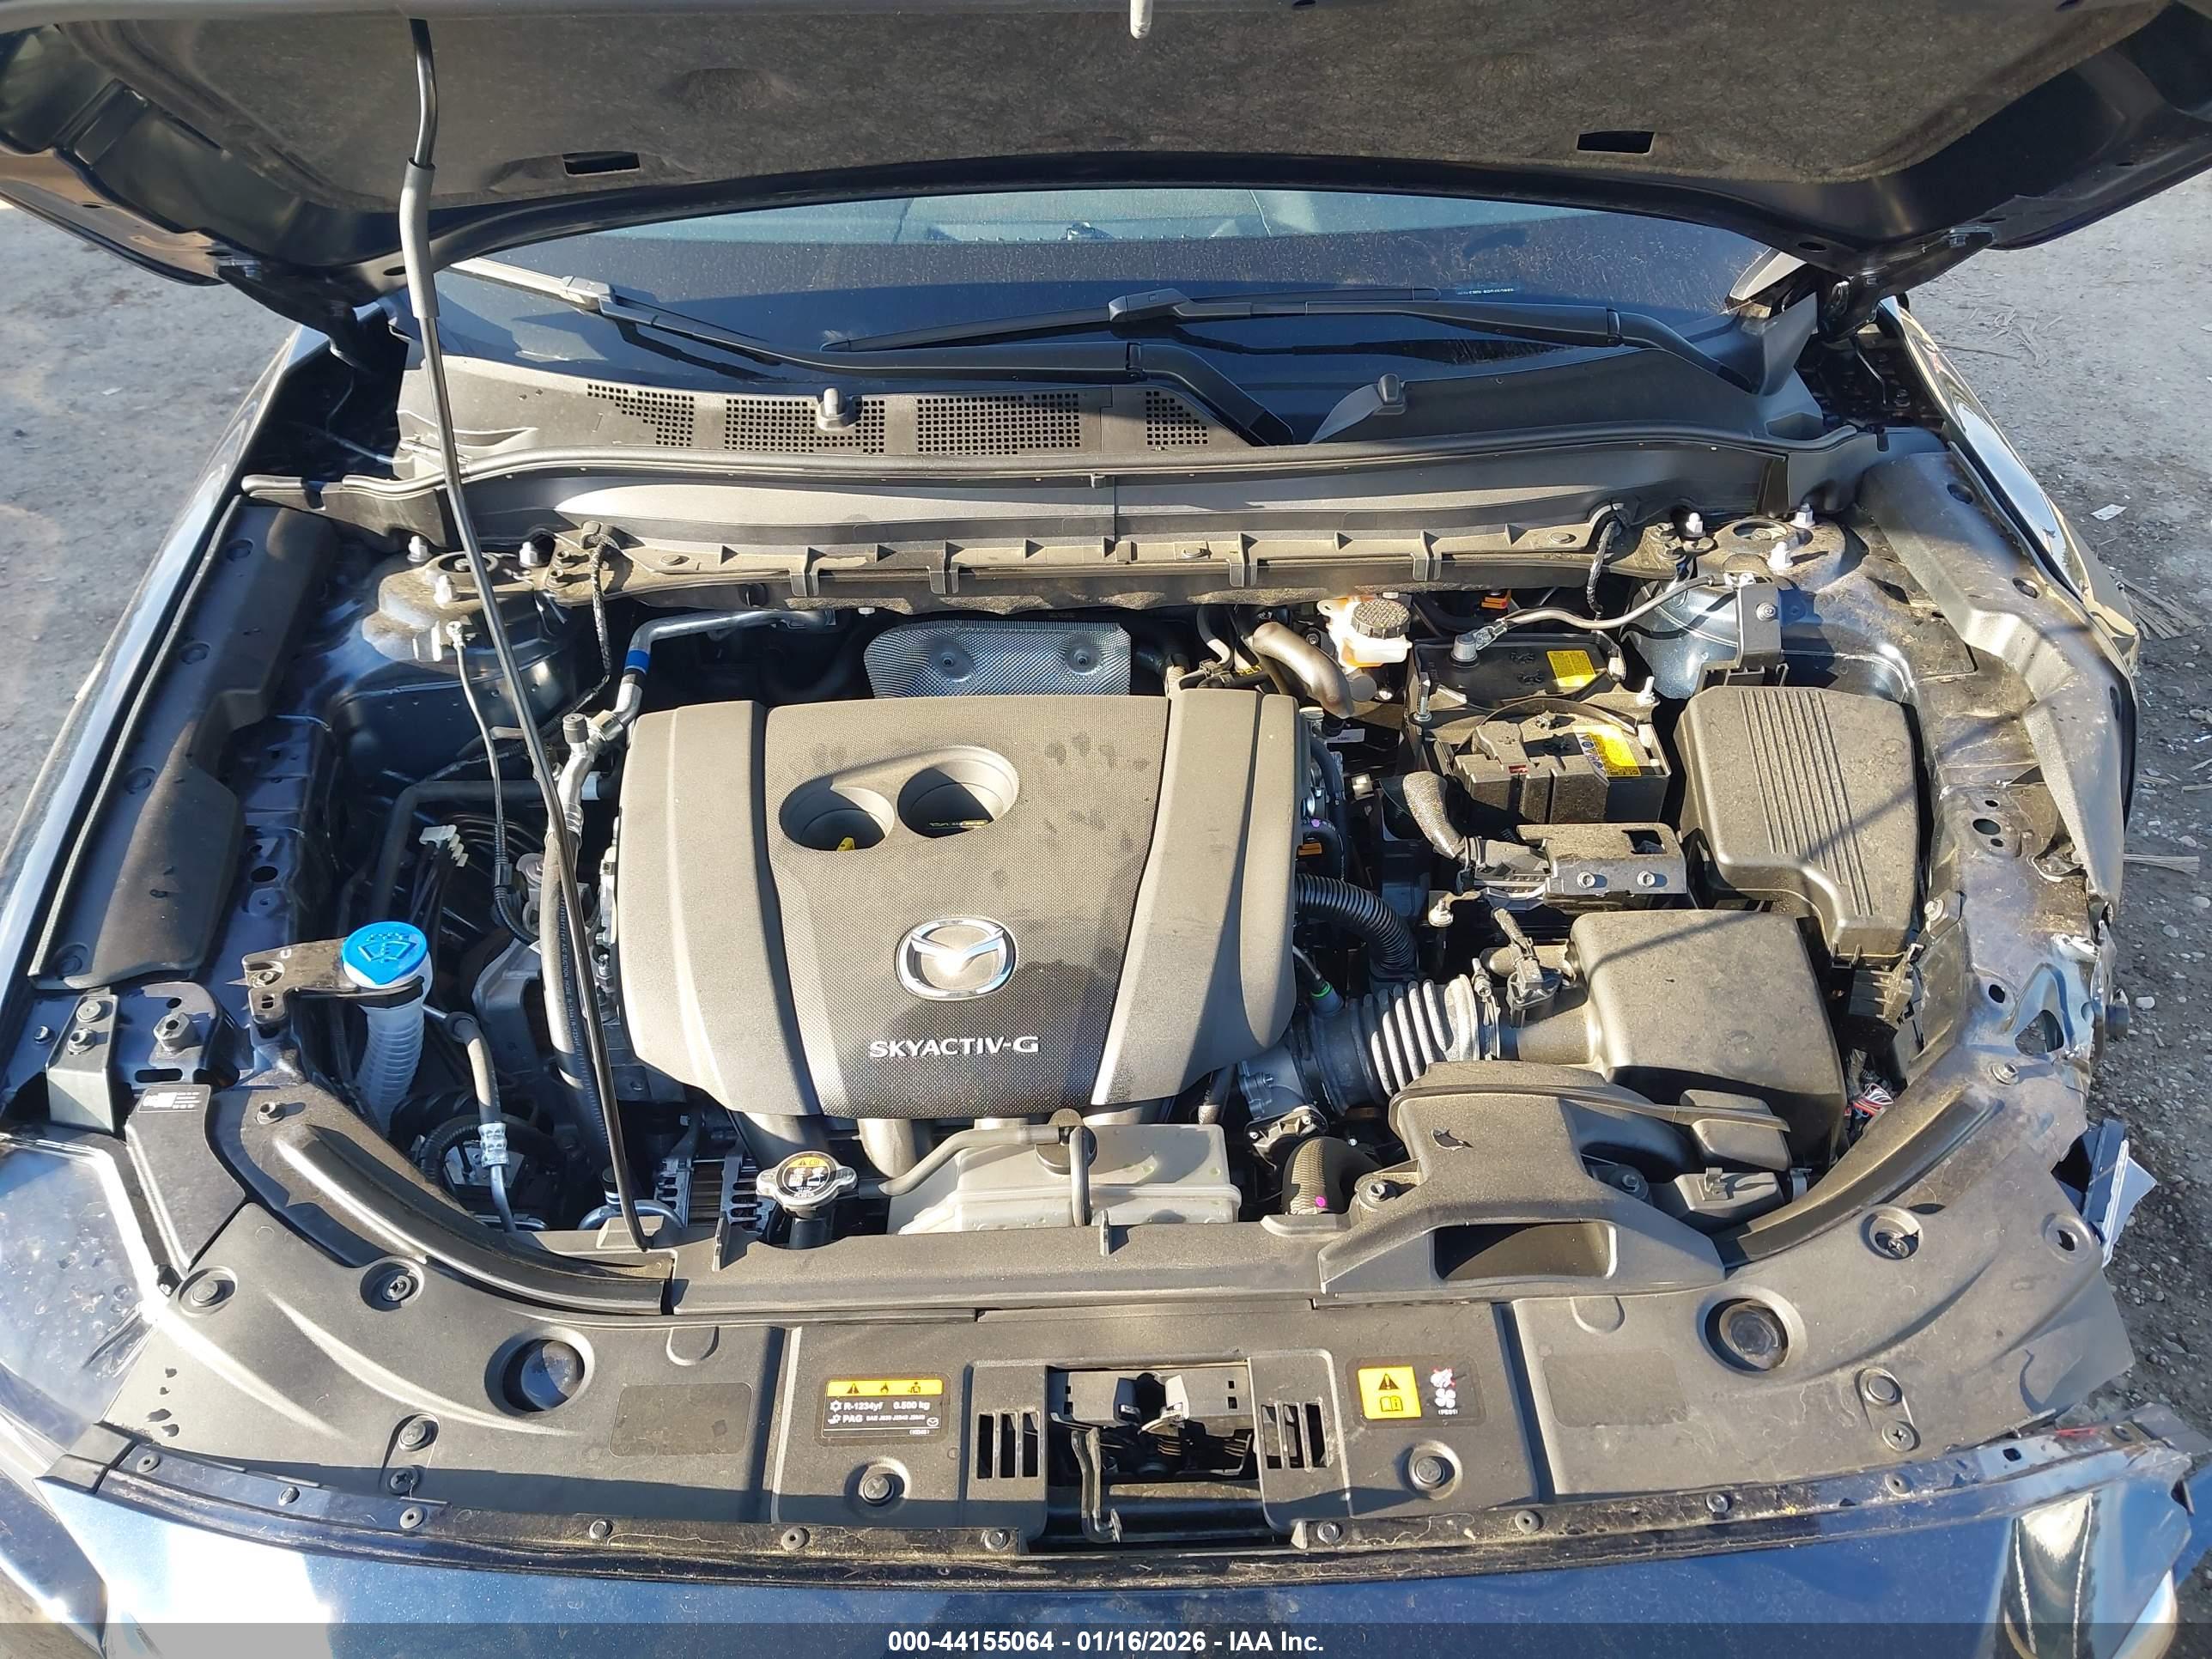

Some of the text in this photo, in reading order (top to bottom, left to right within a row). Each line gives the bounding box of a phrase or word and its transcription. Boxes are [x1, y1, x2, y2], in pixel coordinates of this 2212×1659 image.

[870, 1036, 1039, 1058] SKYACTIV-G
[843, 1401, 931, 1412] R-1234yf 0.500 kg
[842, 1414, 863, 1424] PAG
